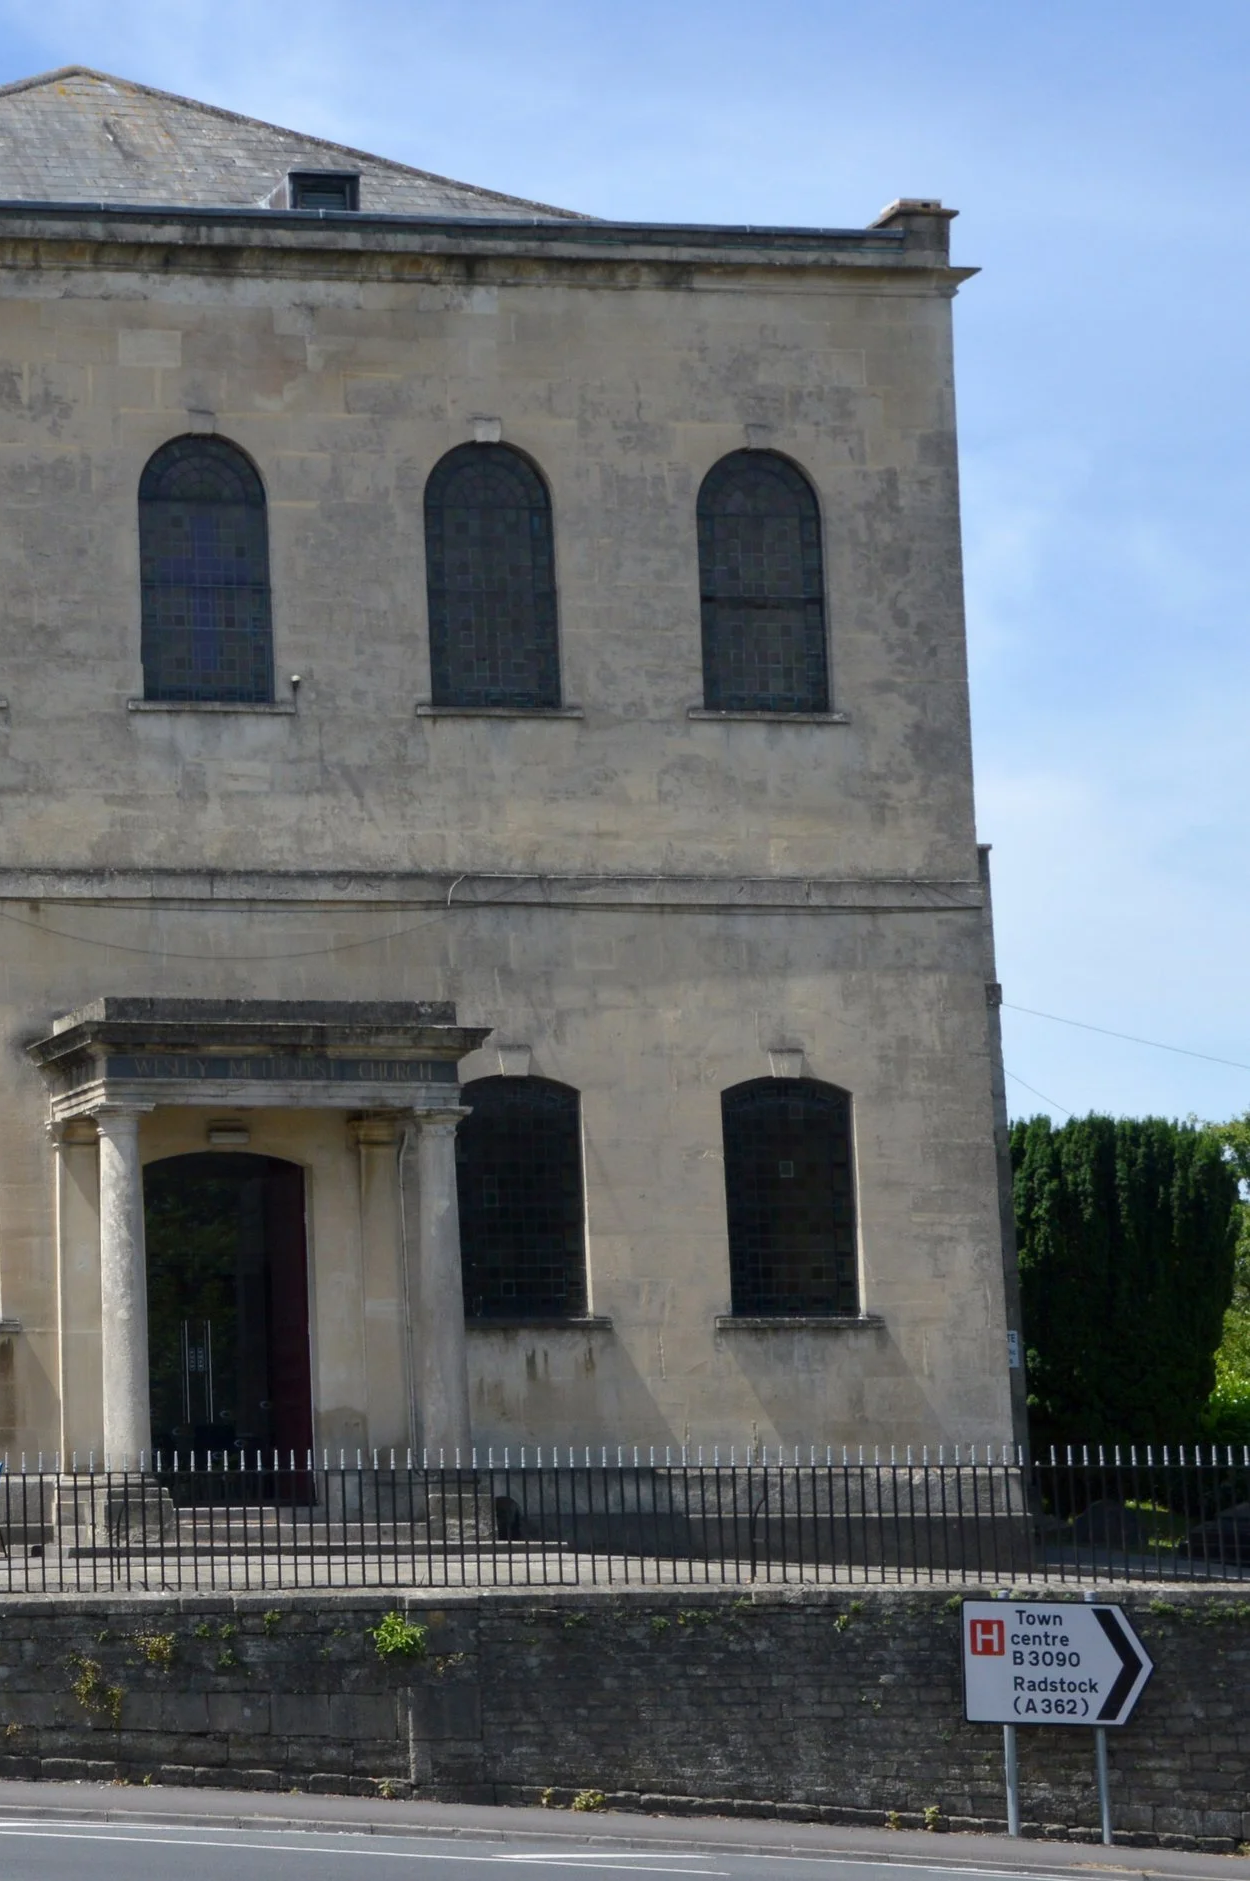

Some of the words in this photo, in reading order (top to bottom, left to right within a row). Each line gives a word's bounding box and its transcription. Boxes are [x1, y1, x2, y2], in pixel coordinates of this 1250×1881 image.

[1015, 1610, 1063, 1626] Town
[976, 1623, 999, 1652] H
[1011, 1631, 1070, 1647] centre
[1013, 1676, 1099, 1694] Radstock
